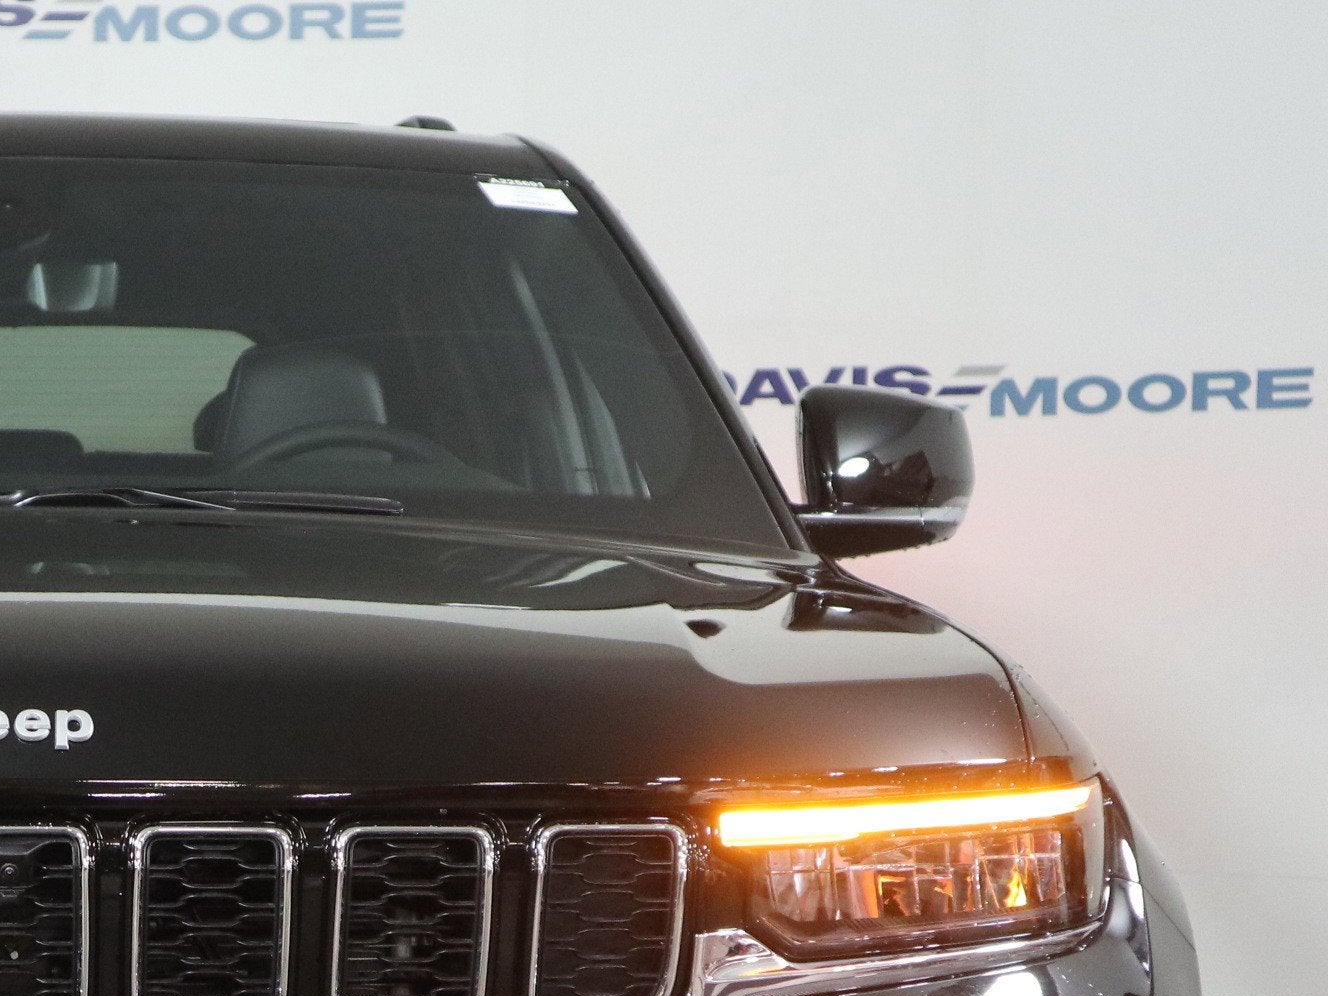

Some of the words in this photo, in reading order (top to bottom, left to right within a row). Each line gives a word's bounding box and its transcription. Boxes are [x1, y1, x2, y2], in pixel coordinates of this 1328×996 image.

[93, 0, 405, 42] MOORE
[722, 365, 932, 406] AVIS
[989, 367, 1315, 417] MOORE
